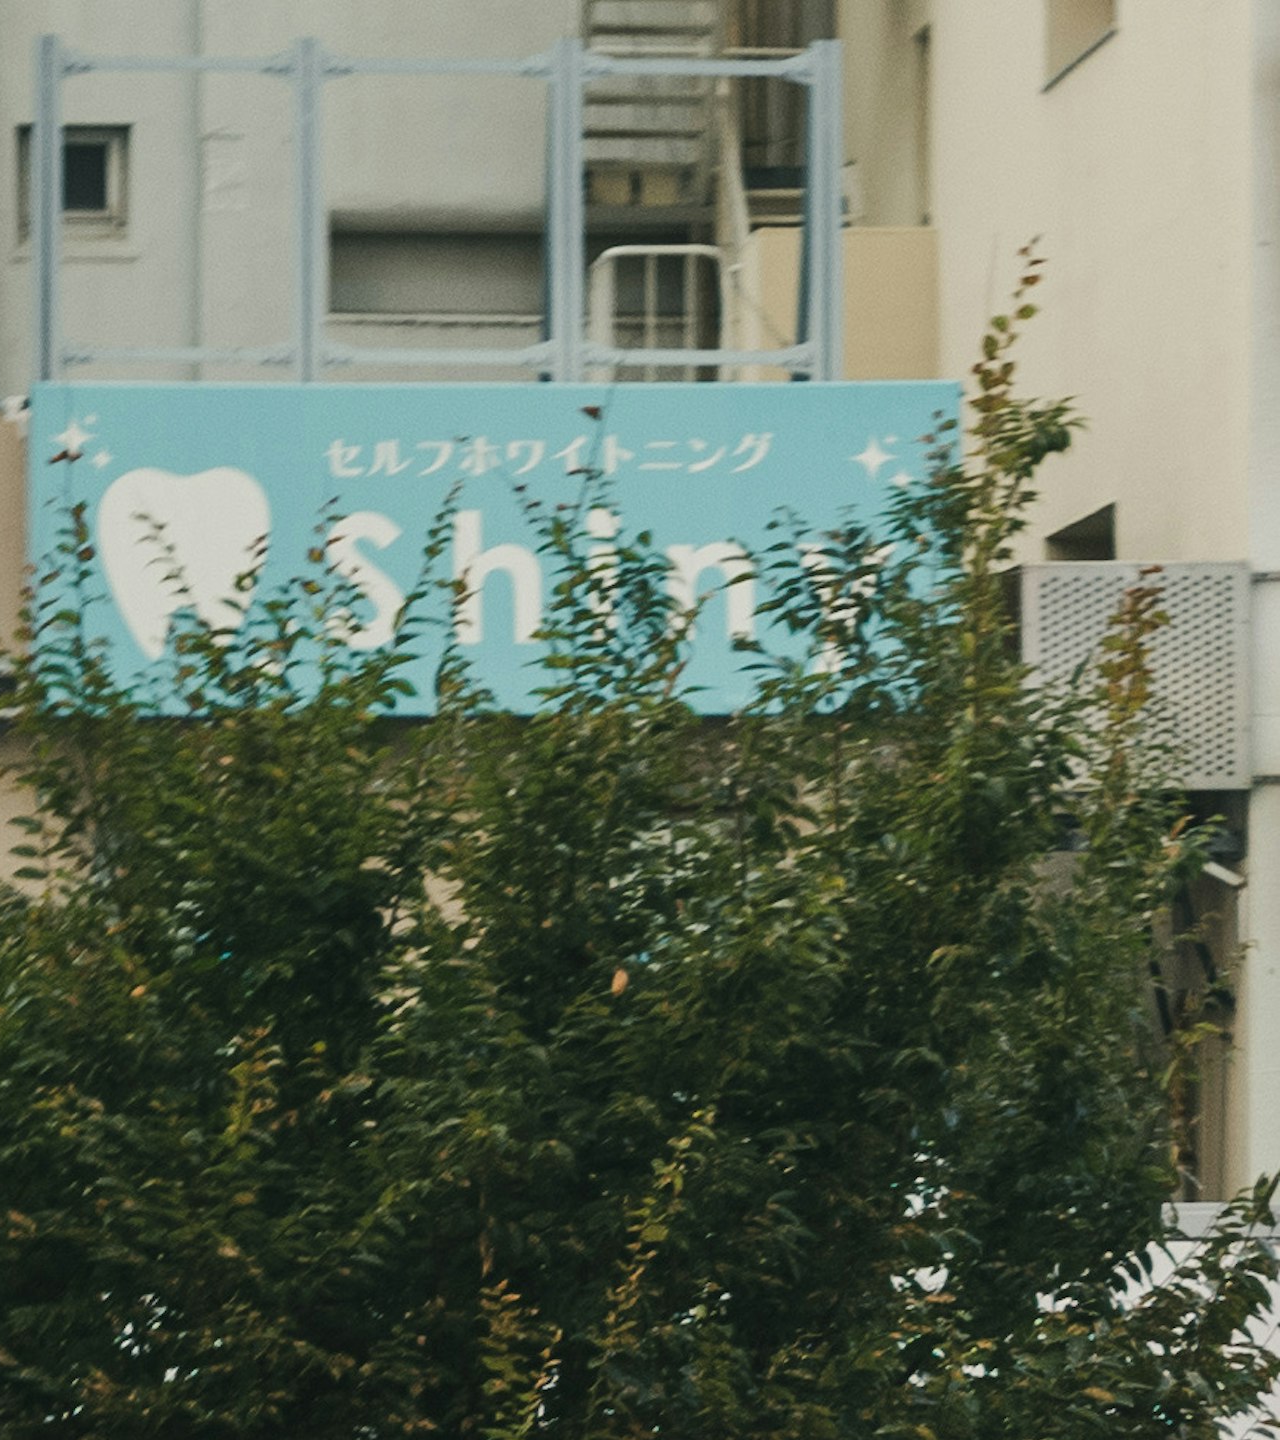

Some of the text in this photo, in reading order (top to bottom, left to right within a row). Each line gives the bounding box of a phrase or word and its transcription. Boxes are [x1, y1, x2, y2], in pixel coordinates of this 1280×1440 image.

[322, 433, 774, 479] セルフホワイトニング
